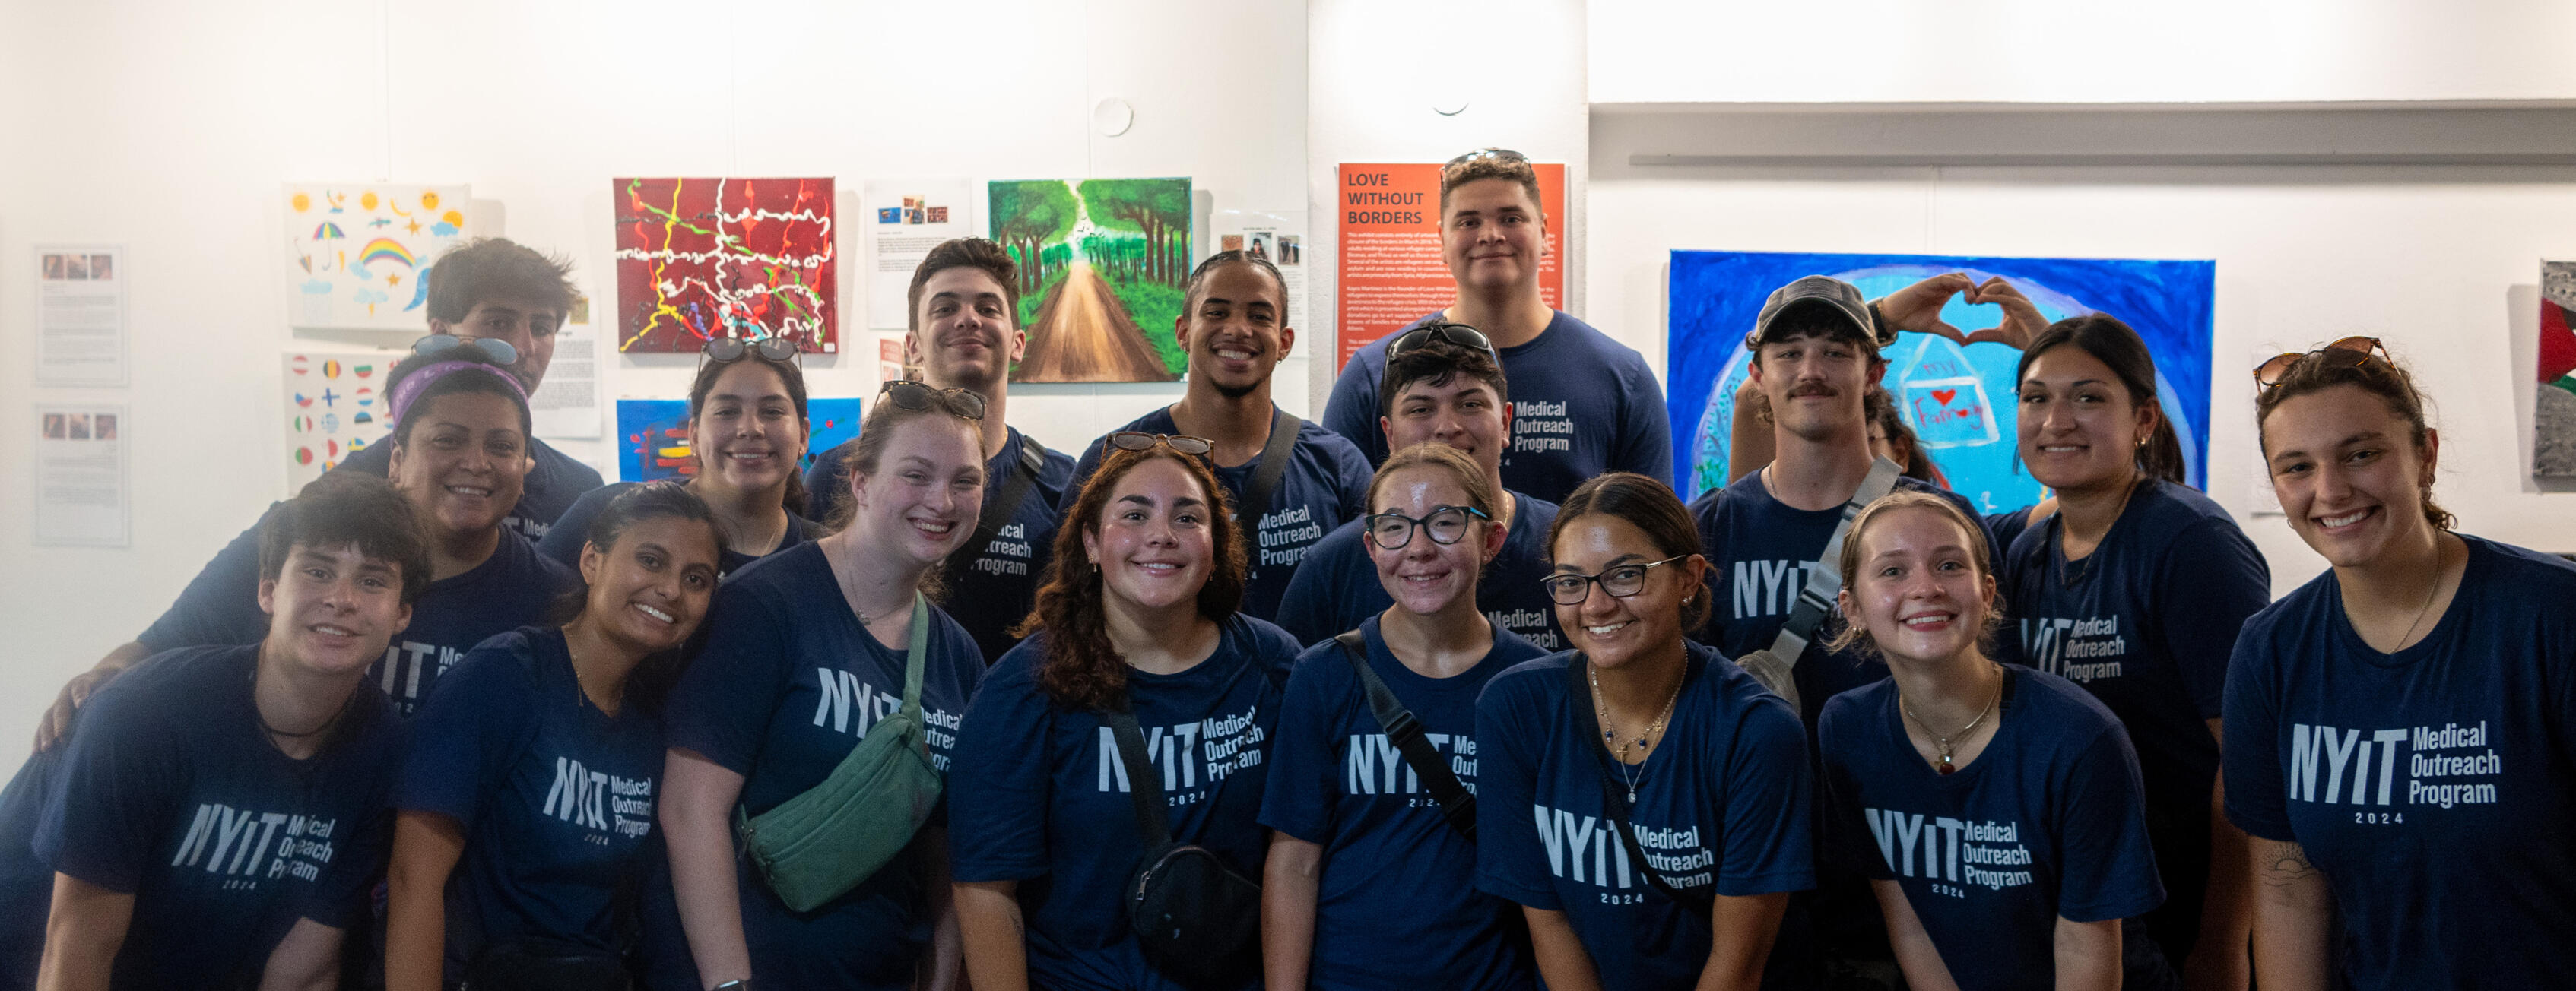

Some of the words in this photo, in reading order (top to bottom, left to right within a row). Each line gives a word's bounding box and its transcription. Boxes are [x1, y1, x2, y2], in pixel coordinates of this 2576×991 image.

[1348, 173, 1388, 186] LOVE
[1348, 192, 1424, 205] WITHOUT
[1348, 211, 1423, 224] BORDERS
[1515, 401, 1566, 417] Medical
[1515, 417, 1574, 435] Outreach
[1515, 435, 1569, 453] Program
[1258, 504, 1311, 530] Medical
[998, 523, 1024, 540] ical
[1258, 521, 1321, 547] Outreach
[985, 540, 1033, 559] treach
[1260, 546, 1308, 566] Progra
[970, 557, 1027, 575] rogram
[1488, 608, 1548, 628] Medical
[2064, 635, 2126, 659] Outreach
[2063, 660, 2121, 684] Program
[921, 704, 963, 731] edica
[2412, 720, 2486, 752] Medical
[2410, 749, 2501, 778] Outreach
[611, 774, 652, 796] Medical
[2409, 780, 2497, 809] Program
[1169, 790, 1206, 807] 2024
[2355, 812, 2403, 825] 2024
[1634, 824, 1700, 850] Medical
[1964, 820, 2018, 843] Medical
[1639, 845, 1714, 872] utreach
[1963, 843, 2032, 866] Outreach
[1964, 864, 2033, 891] Program
[1600, 892, 1644, 905] 2024
[1931, 883, 1965, 899] 2024
